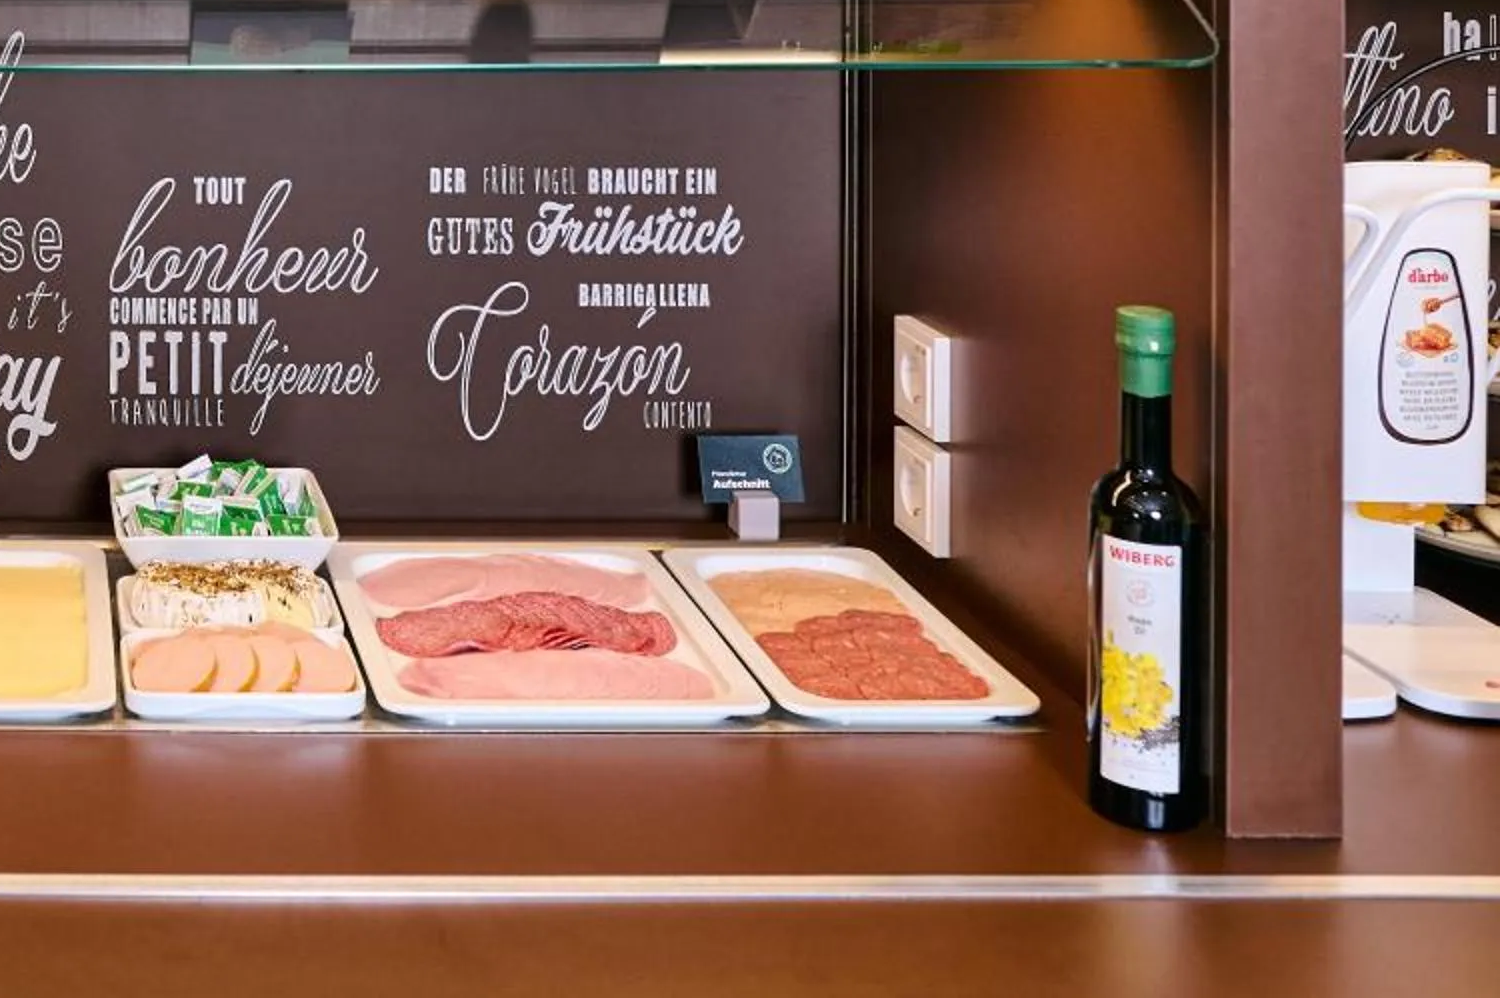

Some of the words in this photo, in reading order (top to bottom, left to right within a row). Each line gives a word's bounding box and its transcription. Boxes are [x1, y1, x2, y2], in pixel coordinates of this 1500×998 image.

[1343, 21, 1455, 137] ttino
[193, 176, 246, 205] TOUT
[429, 167, 467, 194] DER
[483, 164, 525, 195] FRÜHE
[534, 167, 577, 195] VOGEL
[587, 167, 679, 195] BRAUCHT
[685, 167, 717, 195] EIN
[109, 176, 379, 294] bonheur
[427, 217, 514, 256] GUTES
[526, 201, 745, 256] Frühstück
[7, 281, 72, 333] it's
[109, 297, 197, 325] COMMENCE
[202, 297, 232, 325] PAR
[237, 297, 258, 325] UN
[578, 283, 656, 308] BARRIGA
[659, 283, 711, 307] LLENA
[109, 329, 228, 396] PETIT
[230, 318, 381, 435] déjeuner
[427, 281, 691, 441] Corazón
[109, 398, 224, 427] TRANQUILLE
[643, 401, 711, 429] CONTENTO
[1109, 545, 1174, 567] WIBERG
